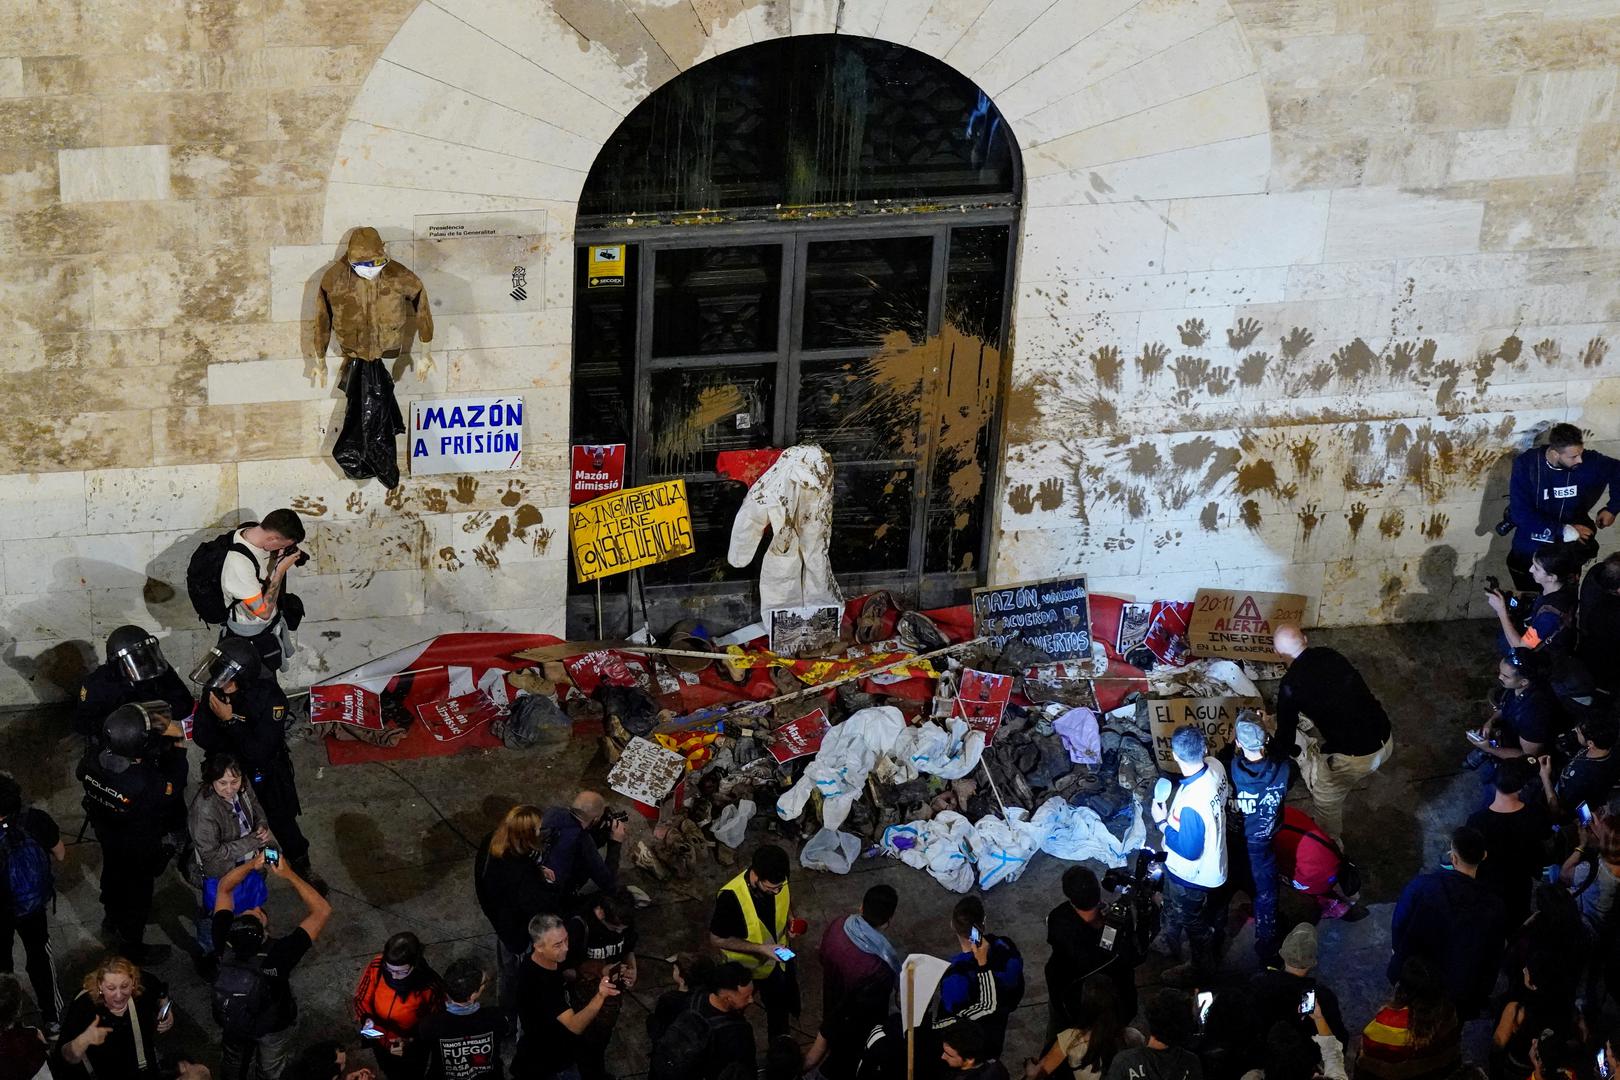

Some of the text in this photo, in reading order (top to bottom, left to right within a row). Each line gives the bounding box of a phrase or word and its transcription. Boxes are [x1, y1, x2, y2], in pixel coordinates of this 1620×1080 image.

[416, 399, 523, 430] ¡MAZÓN
[413, 438, 429, 457] A
[440, 429, 519, 455] PRISIÓN
[575, 470, 609, 480] Mazón
[574, 480, 619, 490] dimissió
[603, 512, 655, 535] TIENE
[577, 516, 692, 576] CONSECUENCIAS
[1002, 609, 1058, 629] ACUERDA
[1063, 606, 1079, 619] DE
[1215, 618, 1271, 634] ALERTA
[1156, 706, 1174, 722] EL
[1185, 706, 1229, 720] AGUA
[443, 1044, 491, 1058] FUEGO
[446, 1063, 470, 1071] CASA
[454, 1056, 467, 1065] LA
